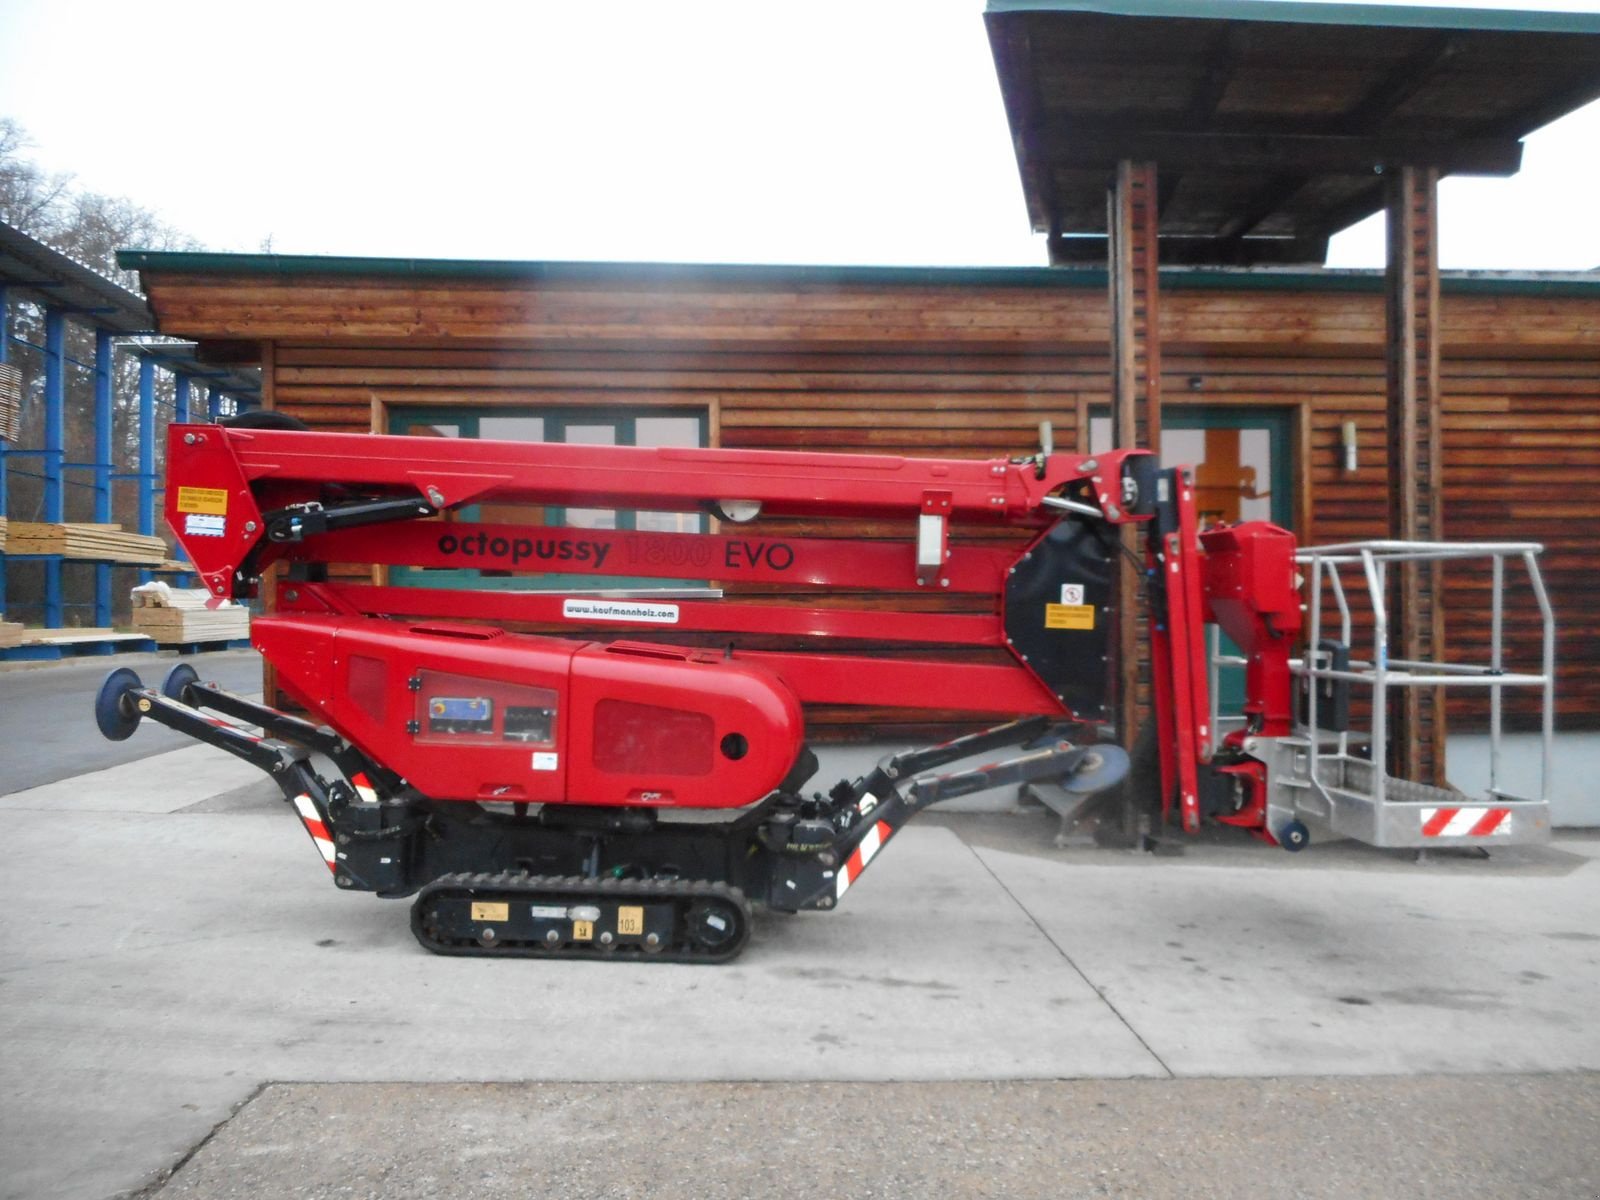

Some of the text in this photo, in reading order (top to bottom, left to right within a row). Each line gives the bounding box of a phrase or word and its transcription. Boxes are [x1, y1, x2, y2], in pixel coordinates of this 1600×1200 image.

[439, 532, 794, 570] octopussy 1800 EVO
[566, 606, 675, 618] www.kaufmannholz.com
